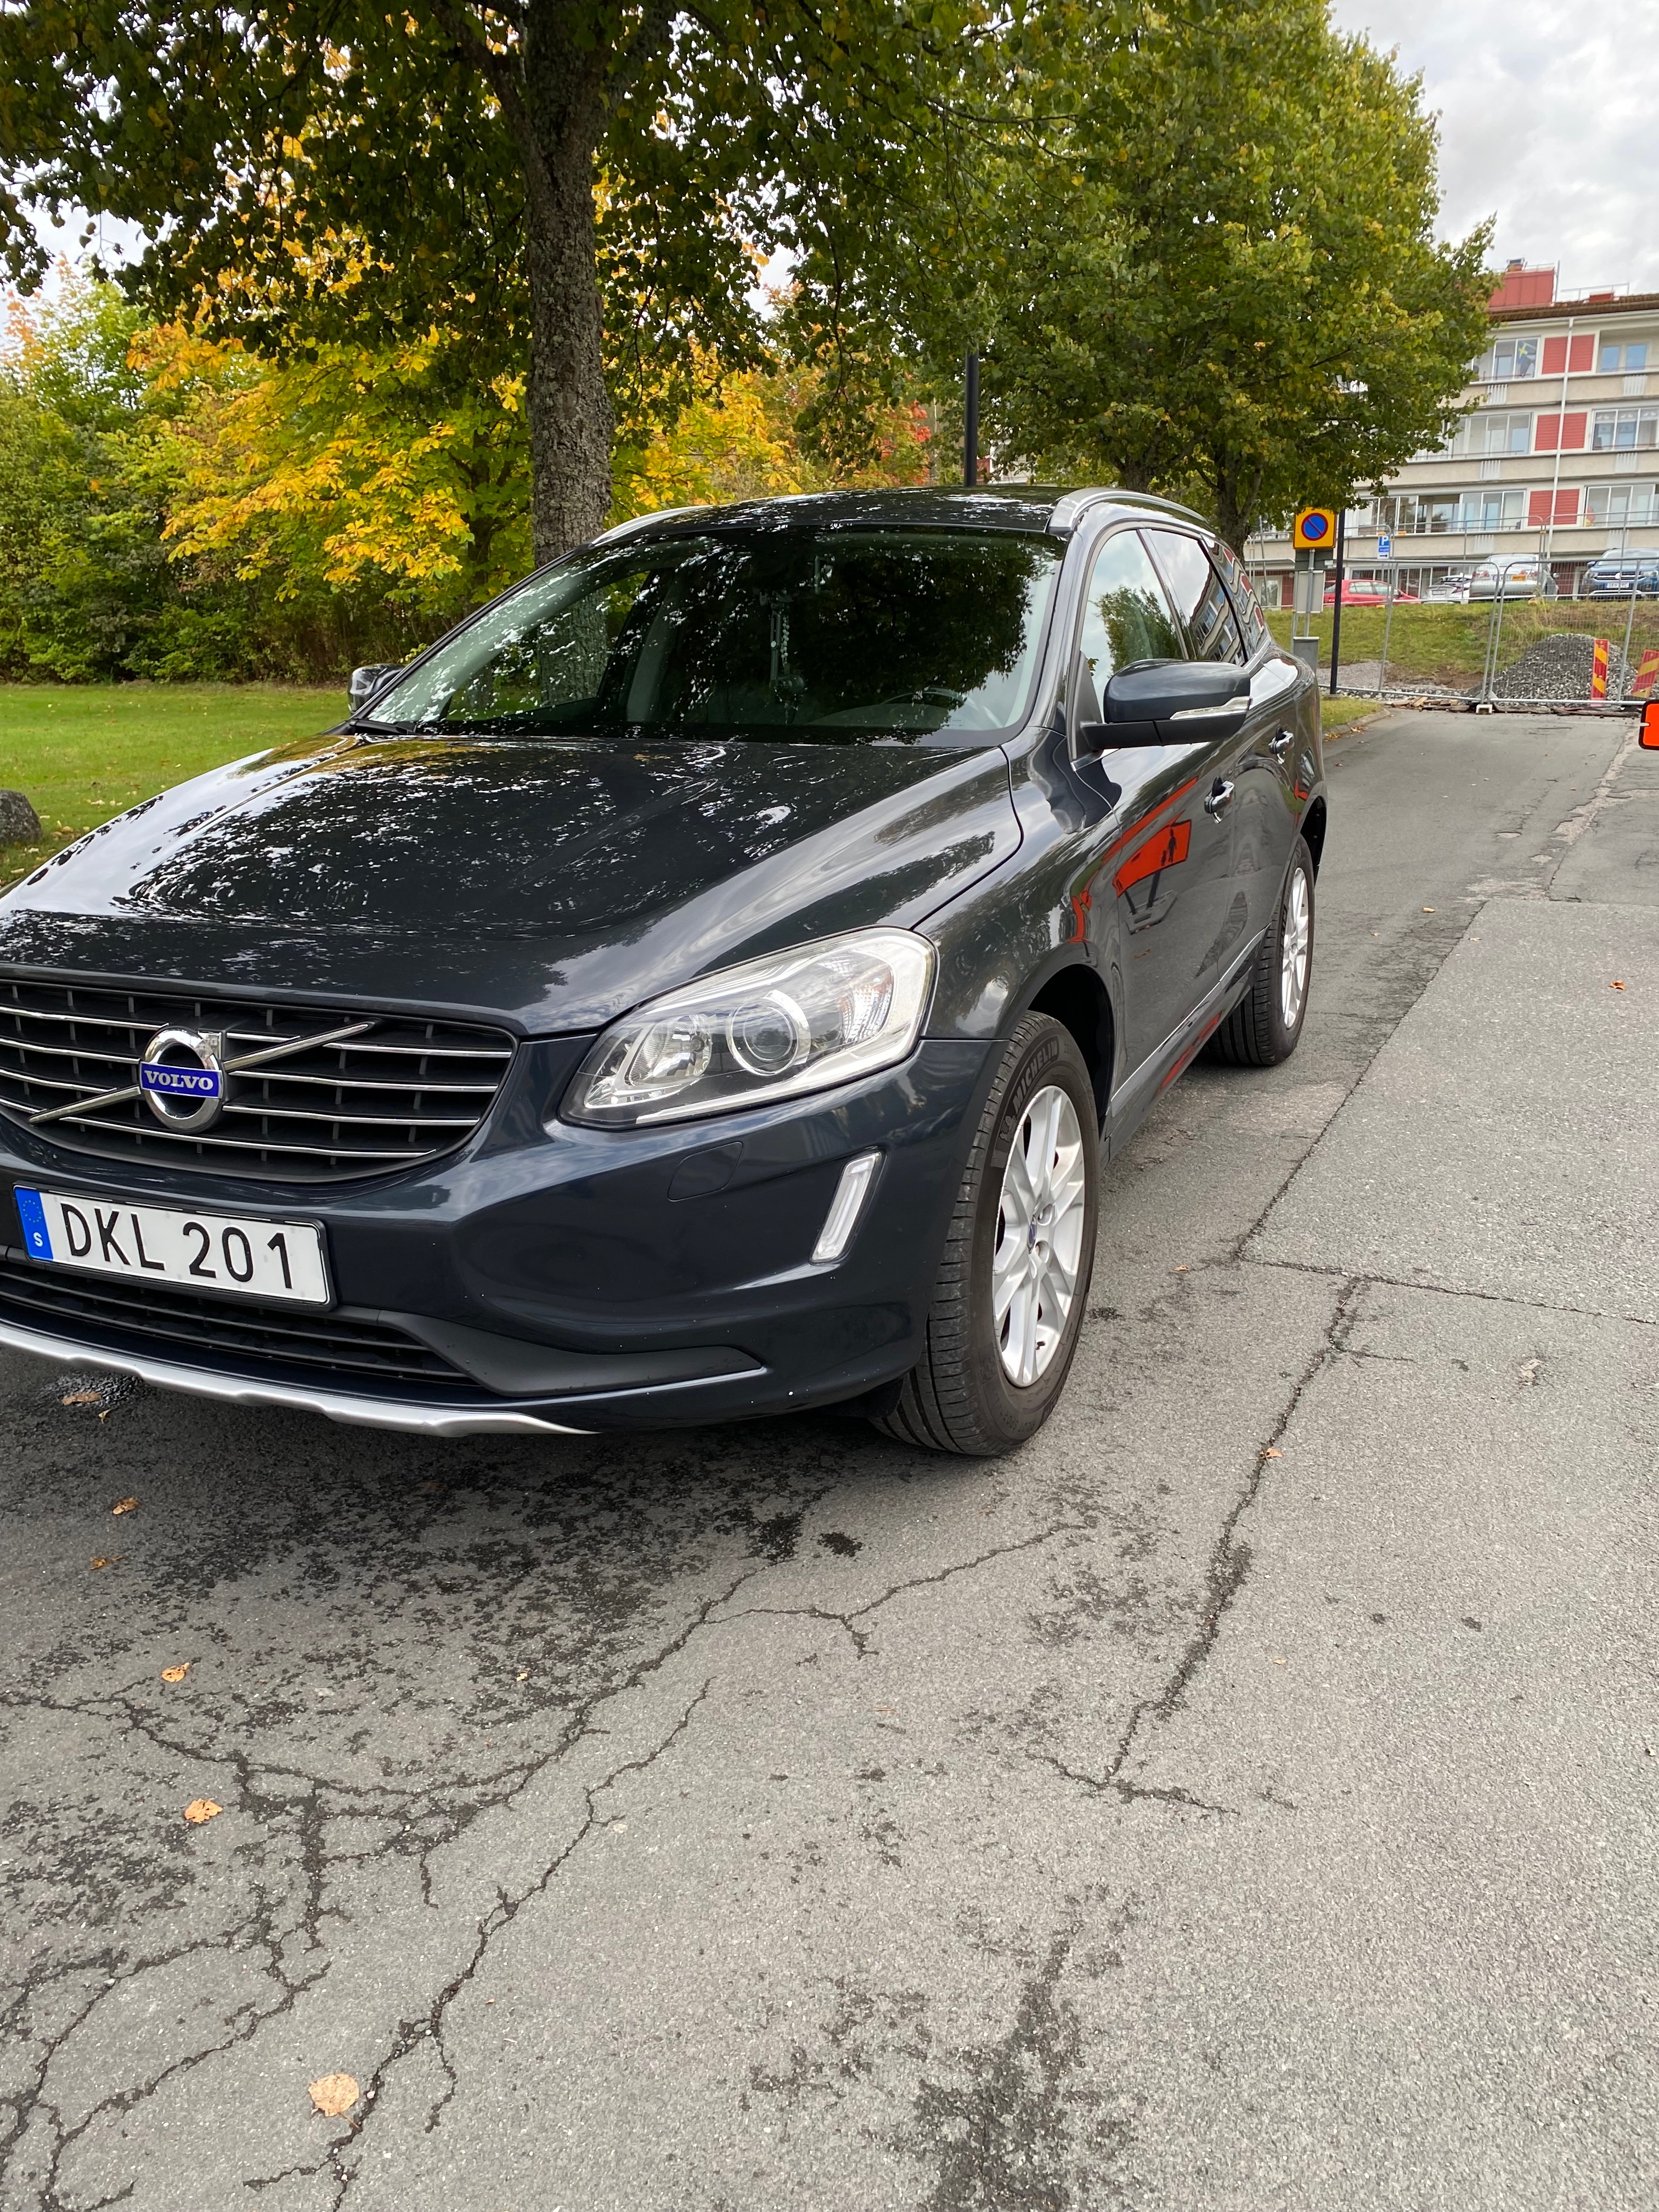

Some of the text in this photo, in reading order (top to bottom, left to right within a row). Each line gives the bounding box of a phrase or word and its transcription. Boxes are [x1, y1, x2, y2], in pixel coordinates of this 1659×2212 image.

[144, 1070, 214, 1091] VOLVO
[1012, 1040, 1058, 1115] MICHELIN
[33, 1232, 43, 1247] S
[60, 1203, 294, 1289] DKL 201
